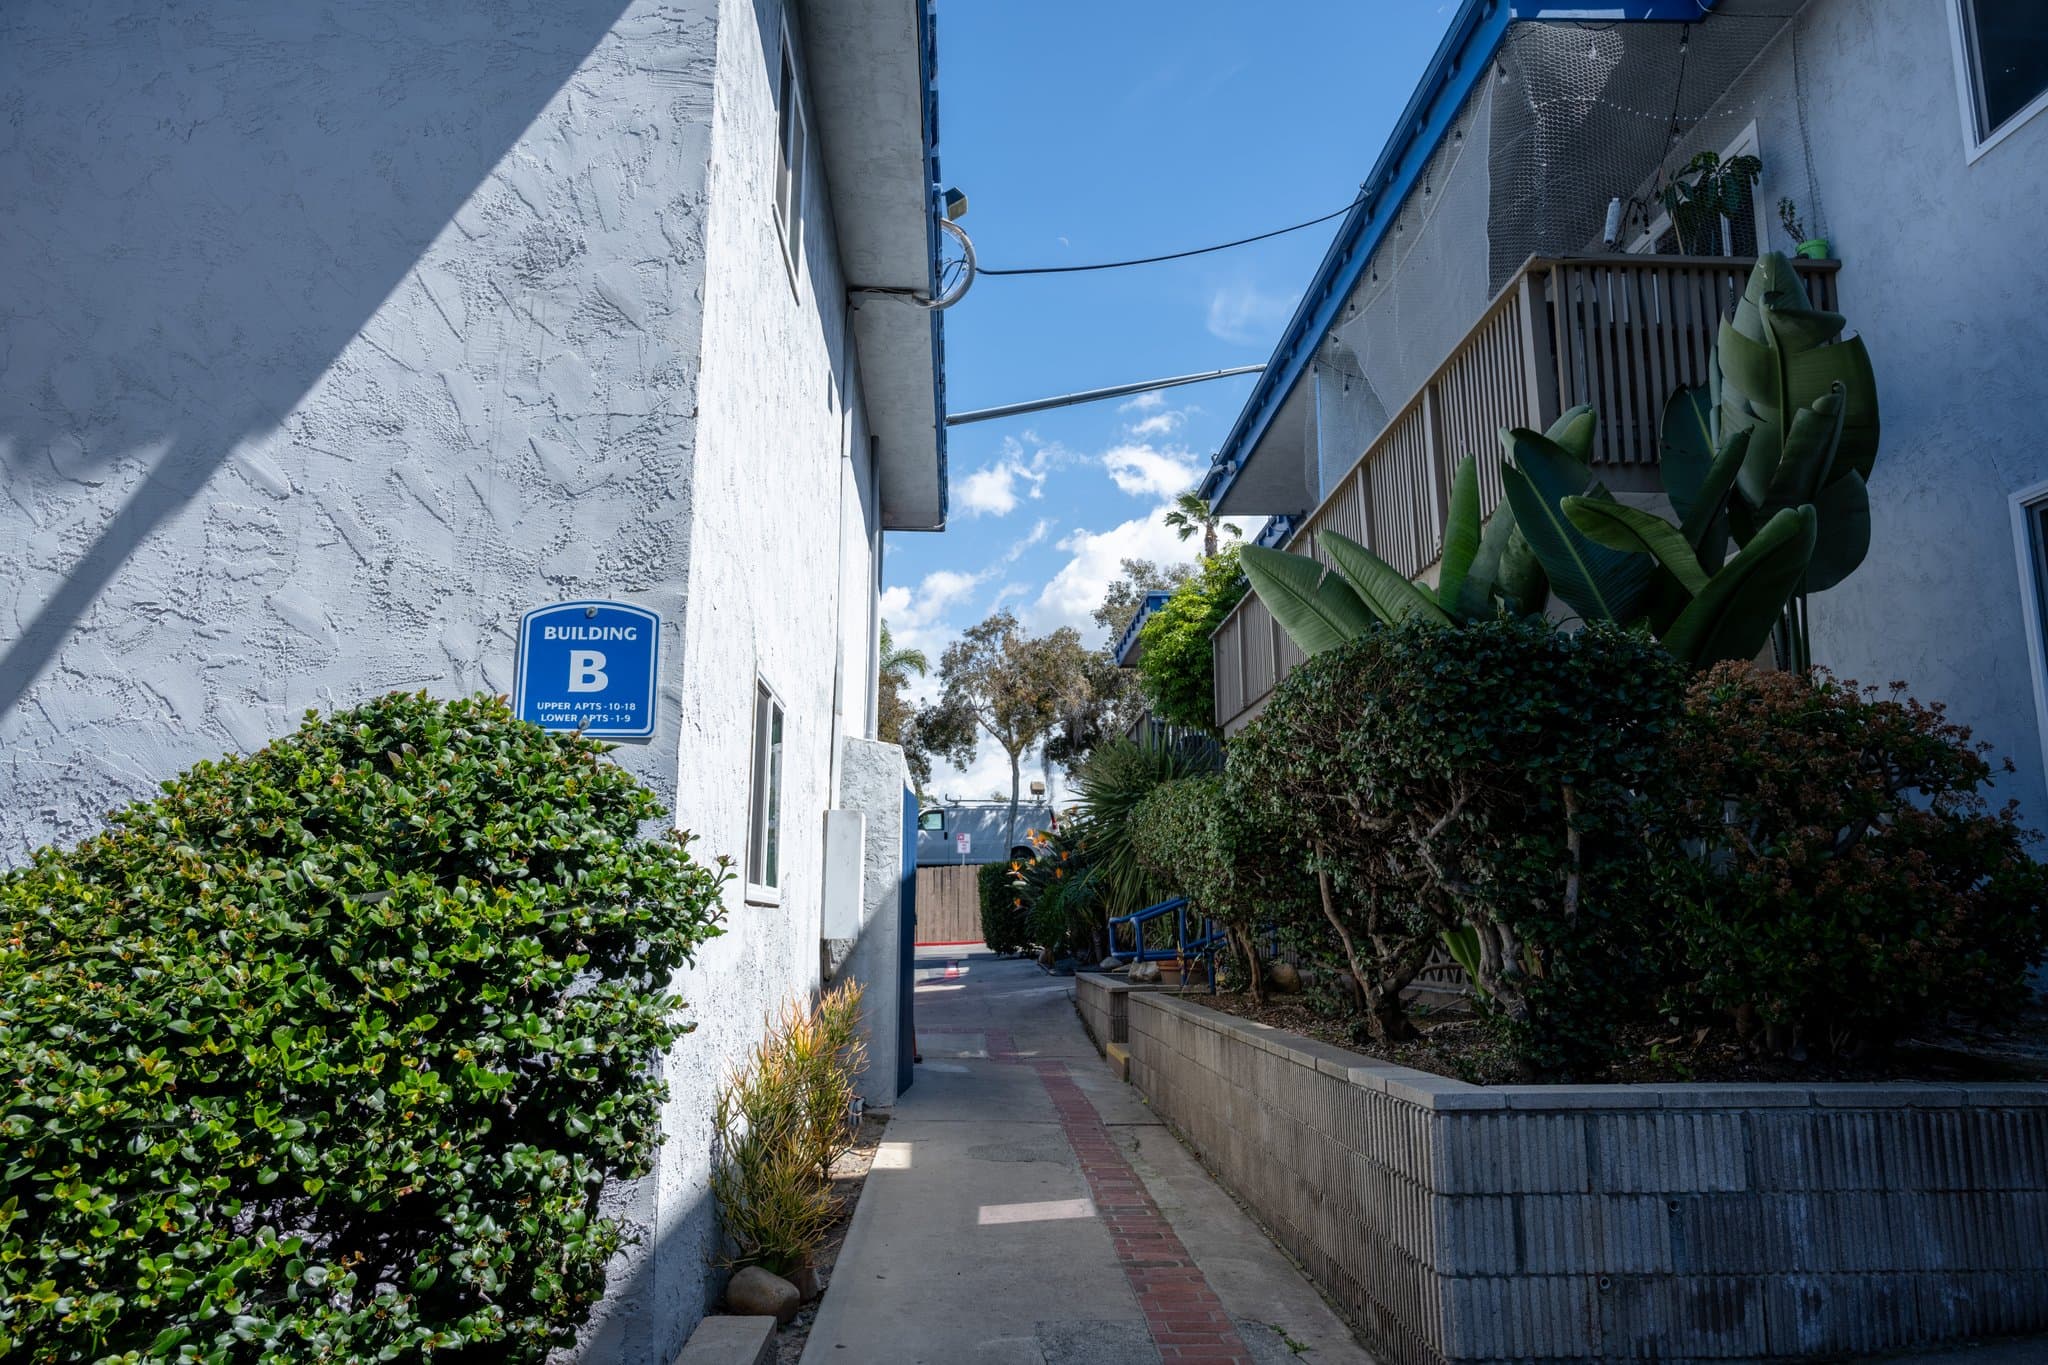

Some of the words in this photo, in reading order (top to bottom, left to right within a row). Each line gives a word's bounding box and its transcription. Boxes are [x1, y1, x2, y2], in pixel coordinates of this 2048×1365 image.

[544, 626, 637, 640] BUILDING
[567, 650, 608, 692] B
[537, 702, 571, 711] UPPER
[574, 702, 602, 711] APTS
[540, 714, 577, 723] LOWER
